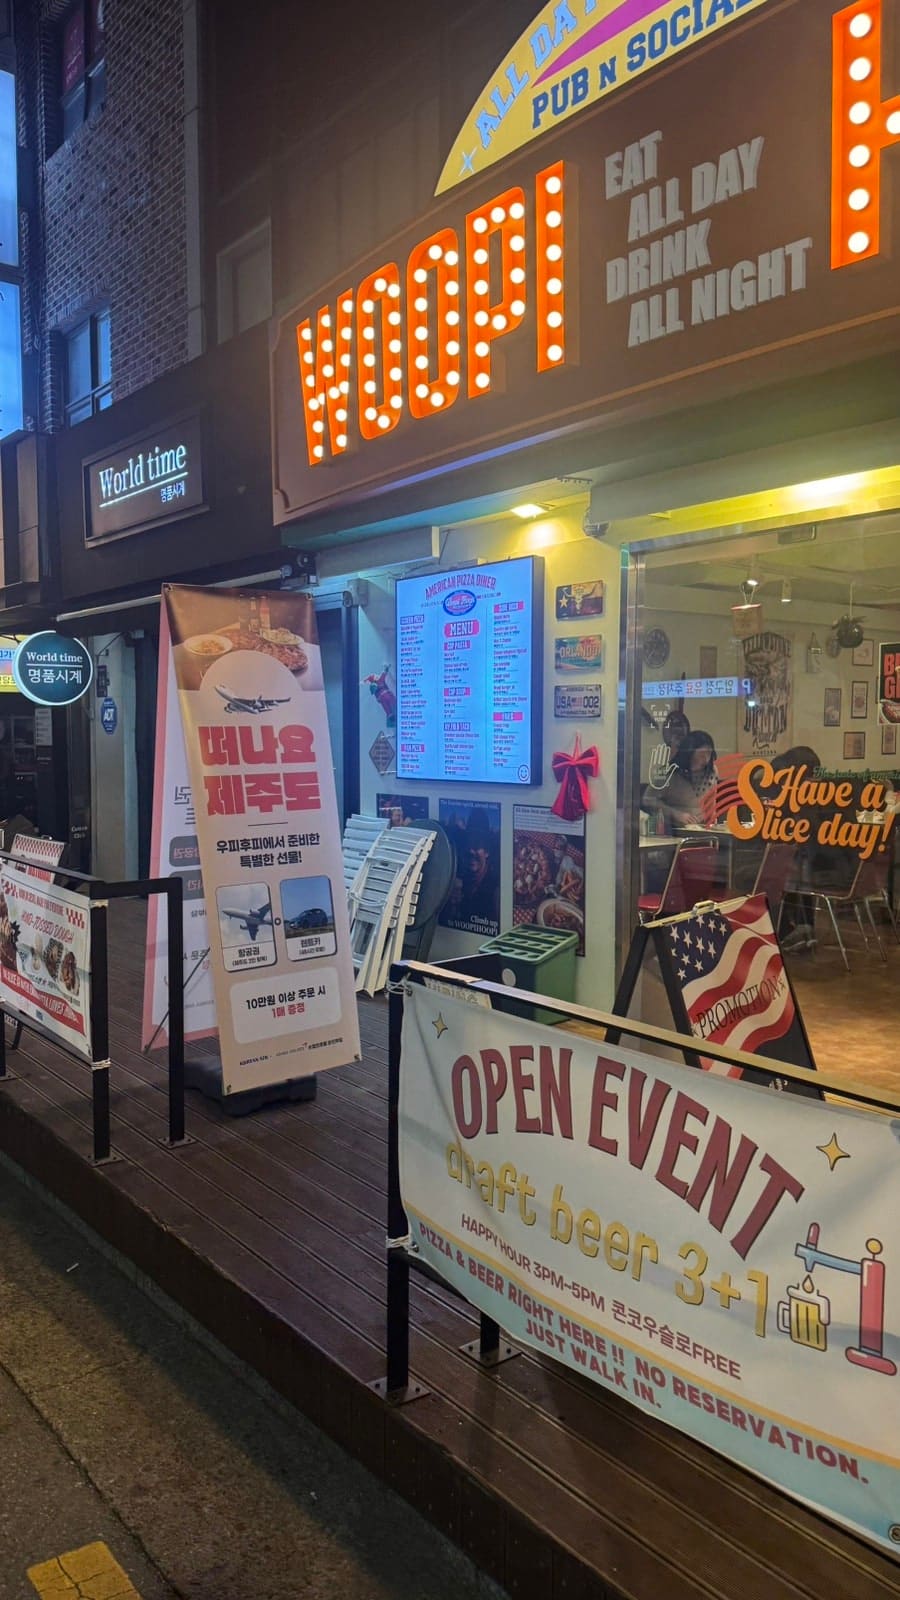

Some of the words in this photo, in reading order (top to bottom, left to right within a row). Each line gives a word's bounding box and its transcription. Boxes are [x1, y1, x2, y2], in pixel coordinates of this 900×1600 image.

[475, 63, 529, 149] ALL
[532, 67, 589, 130] PUB
[604, 130, 662, 200] EAT
[627, 177, 684, 243] ALL
[691, 136, 765, 214] DAY
[606, 218, 712, 304] DRINK
[296, 160, 566, 466] WOOPI
[627, 287, 684, 348] ALL
[691, 237, 812, 326] NIGHT
[99, 453, 145, 499] World
[147, 444, 187, 480] time
[160, 480, 185, 503] 명품시계
[425, 576, 457, 600] AMERICAN
[457, 573, 475, 587] PIZZA
[476, 574, 497, 590] DINER
[450, 621, 474, 637] MENU
[560, 645, 600, 658] ORLANDO
[26, 652, 57, 663] World
[59, 652, 83, 663] time
[28, 668, 82, 684] 명품시계
[556, 696, 571, 709] USA
[583, 695, 599, 709] 002
[198, 724, 317, 766] 떠나요
[203, 771, 322, 817] 제주도
[727, 759, 811, 840] Slice
[817, 812, 896, 860] day!
[773, 764, 853, 813] Have
[860, 782, 887, 810] a
[216, 835, 285, 854] 우피후피에서
[287, 832, 320, 848] 준비한
[240, 854, 274, 868] 특별한
[277, 851, 302, 865] 선물!
[470, 914, 489, 925] Climb
[489, 919, 498, 929] up
[238, 946, 260, 958] 항공권
[246, 994, 276, 1010] 10만원
[278, 991, 296, 1004] 이상
[298, 986, 315, 1000] 주문
[318, 985, 326, 996] 시
[288, 1002, 305, 1014] 증정
[696, 975, 782, 1038] PROMOTION
[451, 1045, 574, 1140] OPEN
[588, 1055, 805, 1260] EVENT
[445, 1143, 537, 1226] draft
[549, 1184, 659, 1281] beer
[675, 1241, 769, 1338] 3+1
[461, 1213, 498, 1246] HAPPY
[500, 1241, 531, 1273] HOUR
[533, 1261, 605, 1312] 3PM~5PM
[419, 1222, 454, 1260] PIZZA
[456, 1250, 465, 1268] &
[468, 1257, 504, 1295] BEER
[508, 1283, 555, 1326] RIGHT
[559, 1317, 607, 1356] HERE
[634, 1356, 666, 1388] NO
[672, 1375, 869, 1484] RESERVATION.
[525, 1319, 566, 1354] JUST
[570, 1343, 628, 1390] WALK
[633, 1378, 662, 1408] IN.
